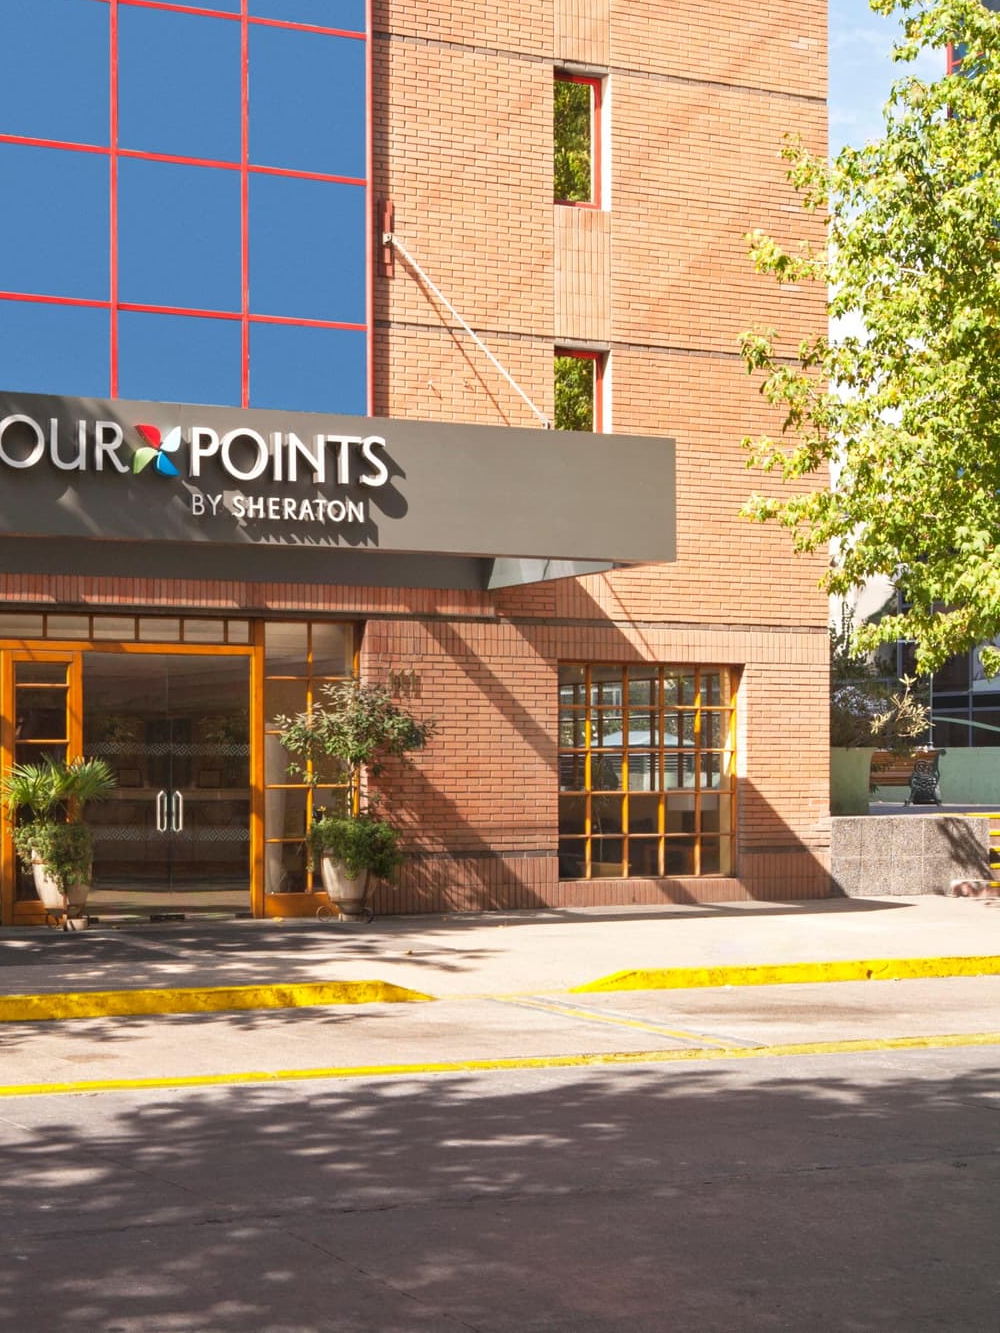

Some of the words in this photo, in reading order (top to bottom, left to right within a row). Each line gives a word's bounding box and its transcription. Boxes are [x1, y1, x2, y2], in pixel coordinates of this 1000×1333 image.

[190, 426, 389, 487] POINTS
[191, 493, 222, 516] BY
[231, 495, 365, 523] SHERATON
